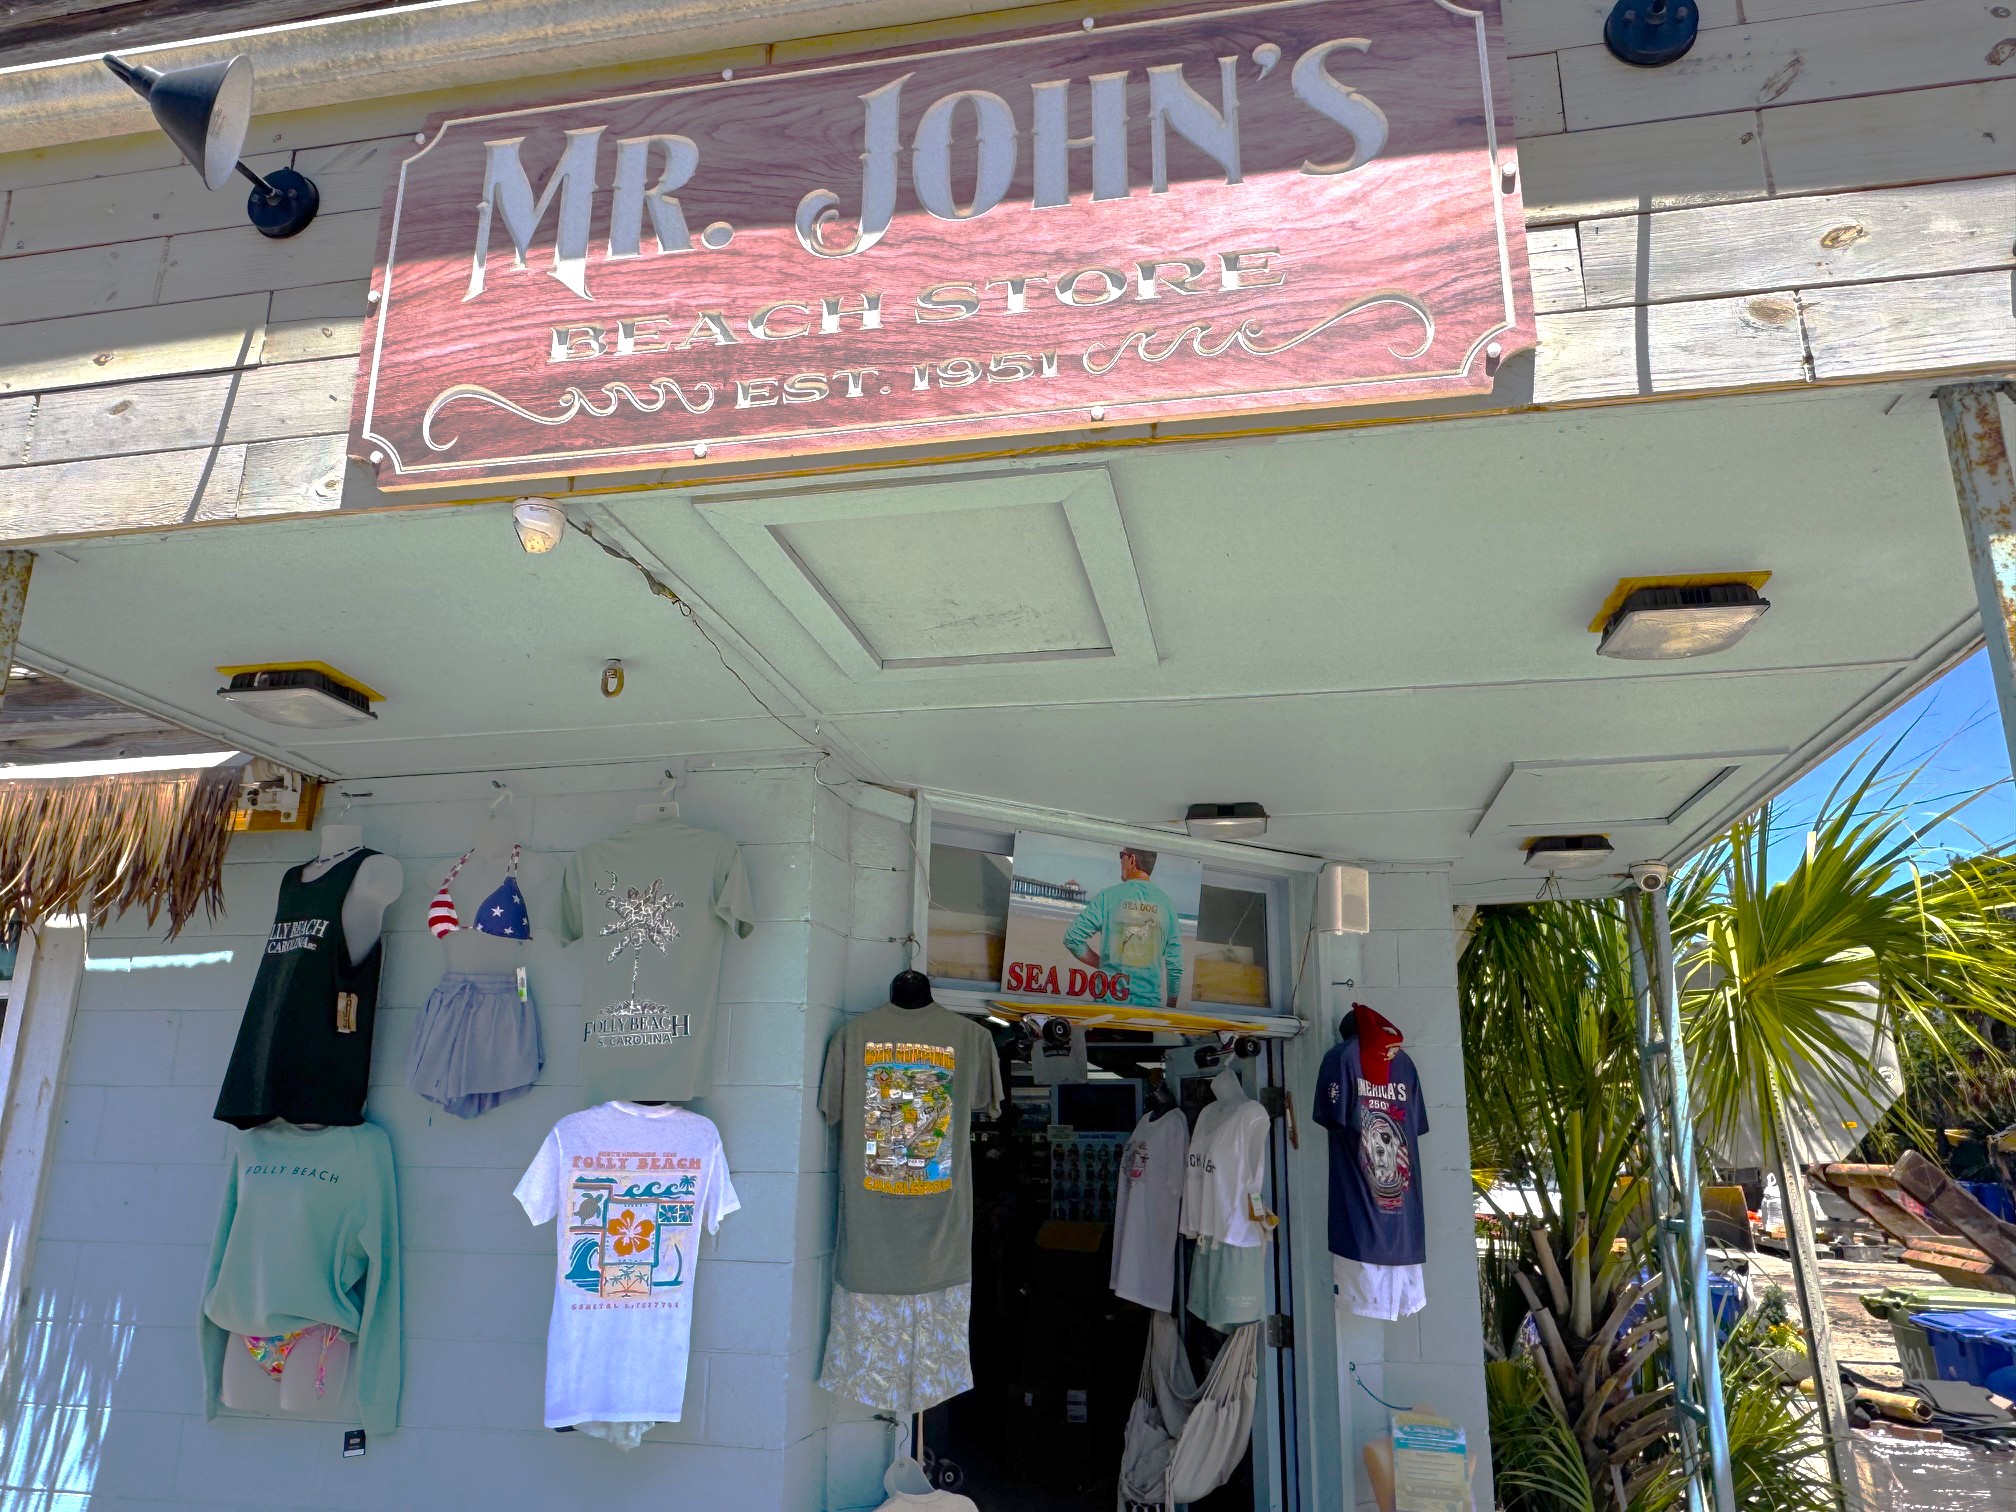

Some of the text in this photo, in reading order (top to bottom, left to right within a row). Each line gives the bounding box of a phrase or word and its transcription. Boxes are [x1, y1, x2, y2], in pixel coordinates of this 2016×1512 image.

[461, 37, 1389, 302] MR. JOHN'S
[547, 246, 1286, 363] BEACH STORE
[734, 352, 1057, 411] EST. 1951
[269, 921, 291, 940] LLY
[1007, 961, 1131, 1001] SEA DOG
[583, 1014, 690, 1043] FOLLY BEACH
[609, 1032, 673, 1047] CAROLINA
[245, 1165, 340, 1184] FOLLY BEACH
[572, 1155, 701, 1170] FOLLY BEACH
